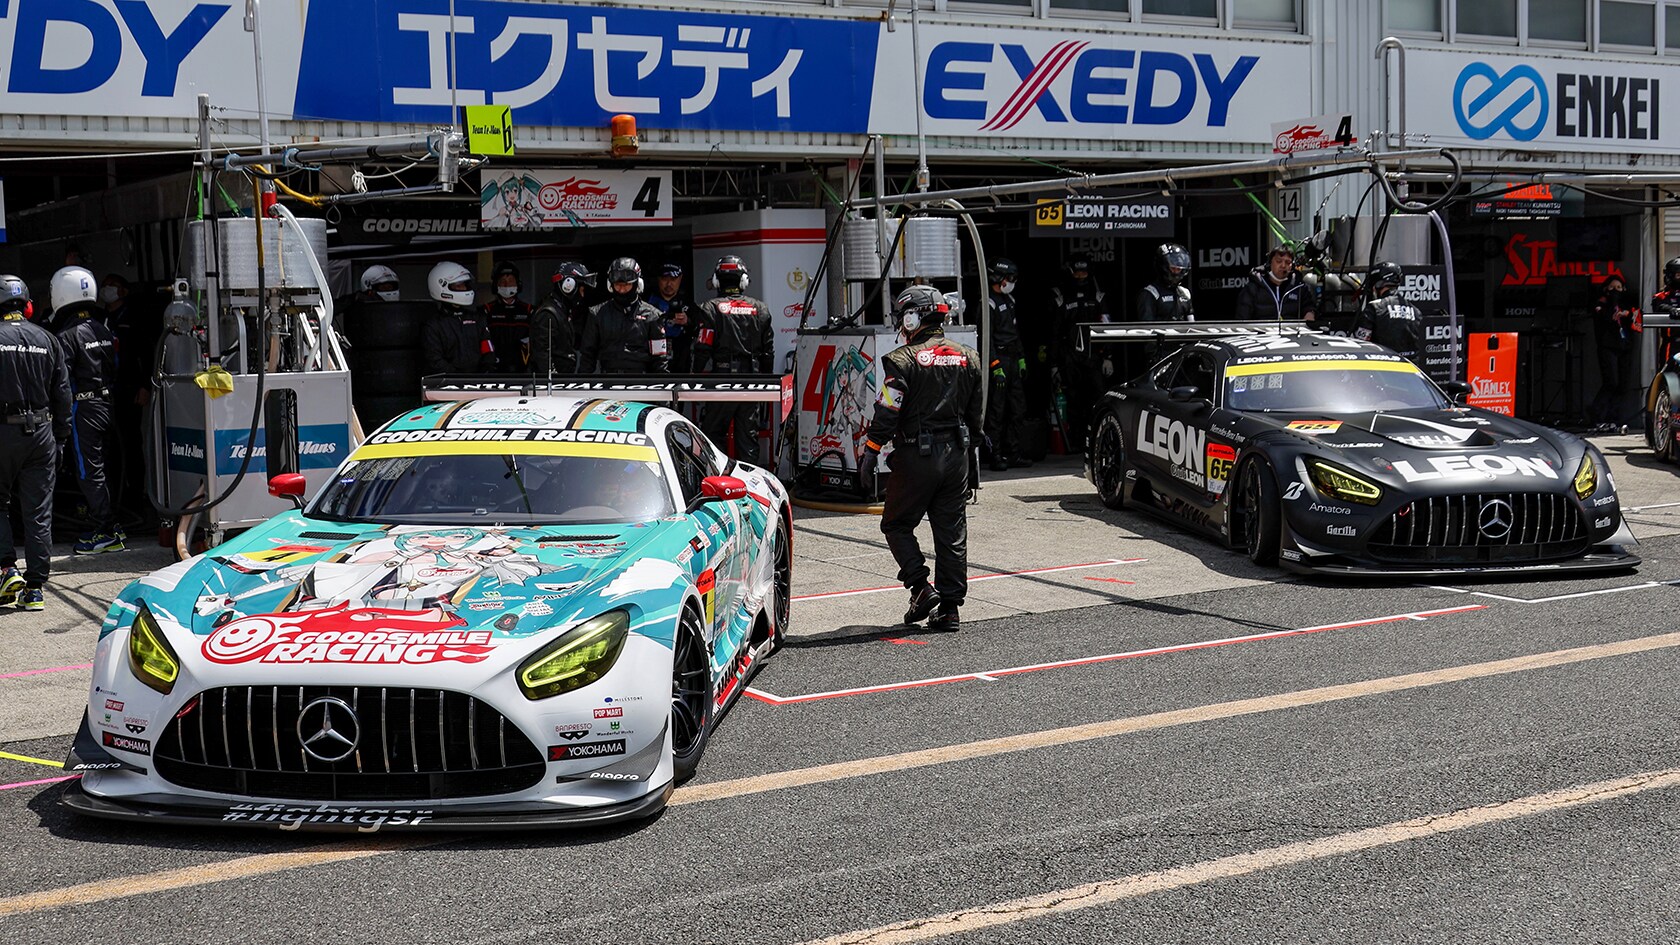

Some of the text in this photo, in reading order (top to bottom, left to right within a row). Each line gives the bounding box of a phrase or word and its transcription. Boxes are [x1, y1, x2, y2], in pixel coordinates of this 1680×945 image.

[0, 0, 231, 97] DY
[393, 12, 804, 118] エクセディ
[923, 40, 1260, 131] EXEDY
[1556, 73, 1660, 141] ENKEI
[502, 106, 512, 154] 6
[1335, 115, 1353, 147] 4
[561, 200, 605, 210] RACING
[566, 193, 618, 201] GOODSMILE
[632, 176, 662, 218] 4
[1280, 191, 1300, 218] 14
[1038, 204, 1061, 221] 65
[1065, 204, 1169, 219] LEON RACING
[363, 218, 479, 233] GOODSMILE
[1199, 247, 1250, 267] LEON
[1387, 304, 1415, 316] LEON
[1505, 307, 1536, 316] HON
[1425, 343, 1463, 353] ClubLEN
[1469, 375, 1512, 399] STANLEY
[370, 429, 647, 446] GOODSMILE RACING
[1136, 410, 1206, 474] LEON
[1210, 457, 1234, 482] 65
[1391, 454, 1560, 483] LEON
[1308, 502, 1351, 515] Amatora
[1326, 524, 1357, 537] Gorilla
[293, 630, 493, 646] GOODSMILE
[260, 644, 440, 664] RACING
[594, 708, 622, 718] POP MART
[555, 722, 593, 733] BANPRESTO
[112, 736, 149, 753] YOKOHAMA
[568, 743, 623, 757] YOKOHAMA
[73, 761, 122, 771] piapro
[589, 772, 640, 781] piapro
